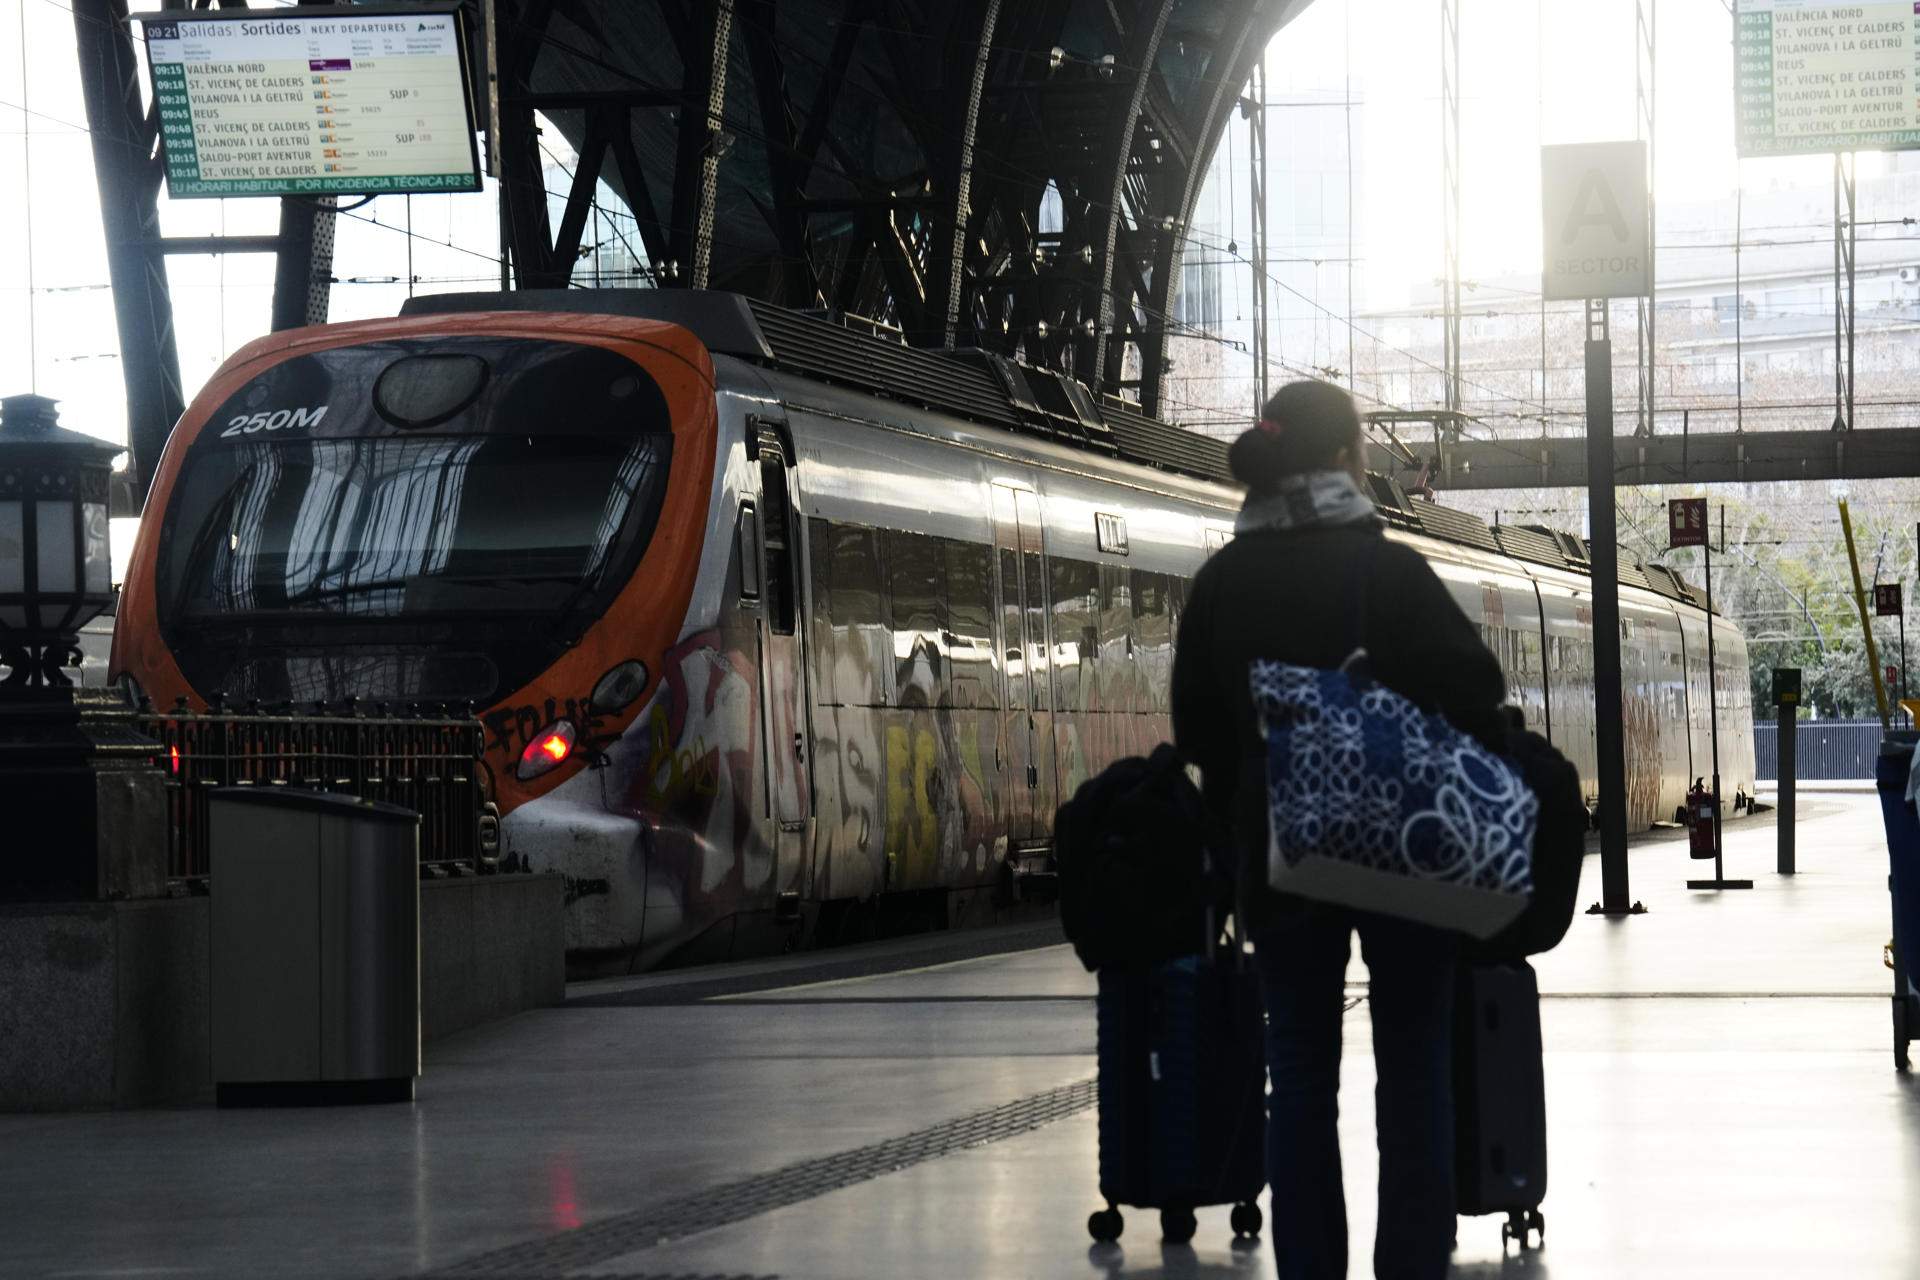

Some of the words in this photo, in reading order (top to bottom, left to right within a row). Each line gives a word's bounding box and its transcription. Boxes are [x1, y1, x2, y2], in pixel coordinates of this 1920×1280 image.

[1832, 8, 1863, 20] NORD
[182, 24, 232, 38] Salidas
[241, 22, 301, 36] Sortides
[311, 24, 336, 34] NEXT
[341, 22, 406, 33] DEPARTURES
[1796, 26, 1835, 38] VICENÇ
[1839, 25, 1854, 35] DE
[1858, 22, 1905, 34] CALDERS
[1776, 42, 1830, 54] VILANOVA
[1842, 40, 1856, 50] LA
[155, 65, 182, 76] 09:15
[238, 64, 266, 74] NORD
[1776, 60, 1805, 70] REUS
[157, 80, 184, 90] 09:18
[188, 80, 204, 90] ST.
[208, 79, 242, 92] VICENÇ
[246, 78, 258, 88] DE
[262, 77, 304, 88] CALDERS
[1798, 73, 1836, 86] VICENÇ
[1840, 72, 1854, 82] DE
[1858, 69, 1906, 81] CALDERS
[160, 95, 187, 104] 09:28
[191, 94, 240, 104] VILANOVA
[250, 94, 262, 103] LA
[266, 92, 304, 102] GELTRÚ
[390, 90, 408, 99] SUP
[1776, 90, 1831, 102] VILANOVA
[1844, 88, 1856, 98] LA
[162, 110, 188, 120] 09:45
[194, 109, 219, 118] REUS
[1778, 104, 1848, 118] SALOU-PORT
[1852, 102, 1903, 114] AVENTUR
[164, 125, 192, 134] 09:48
[196, 124, 212, 134] ST.
[214, 123, 250, 135] VICENÇ
[252, 122, 266, 132] DE
[268, 122, 310, 132] CALDERS
[1841, 119, 1856, 130] DE
[1859, 117, 1906, 128] CALDERS
[166, 140, 194, 148] 09:58
[198, 138, 246, 148] VILANOVA
[257, 138, 269, 146] LA
[272, 136, 310, 146] GELTRÚ
[396, 134, 414, 144] SUP
[1796, 134, 1858, 148] HORARIO
[168, 154, 196, 162] 10:15
[200, 152, 262, 162] SALOU-PORT
[266, 152, 312, 160] AVENTUR
[171, 168, 198, 178] 10:18
[202, 168, 218, 177] ST.
[220, 166, 255, 178] VICENÇ
[258, 166, 270, 176] DE
[274, 165, 316, 176] CALDERS
[186, 182, 232, 192] HORARI
[296, 179, 321, 190] POR
[324, 178, 390, 189] INCIDENCIA
[394, 176, 442, 187] TÉCNICA
[446, 176, 460, 186] R2
[1562, 168, 1630, 244] A
[1554, 256, 1639, 274] SECTOR
[220, 406, 328, 438] 250M
